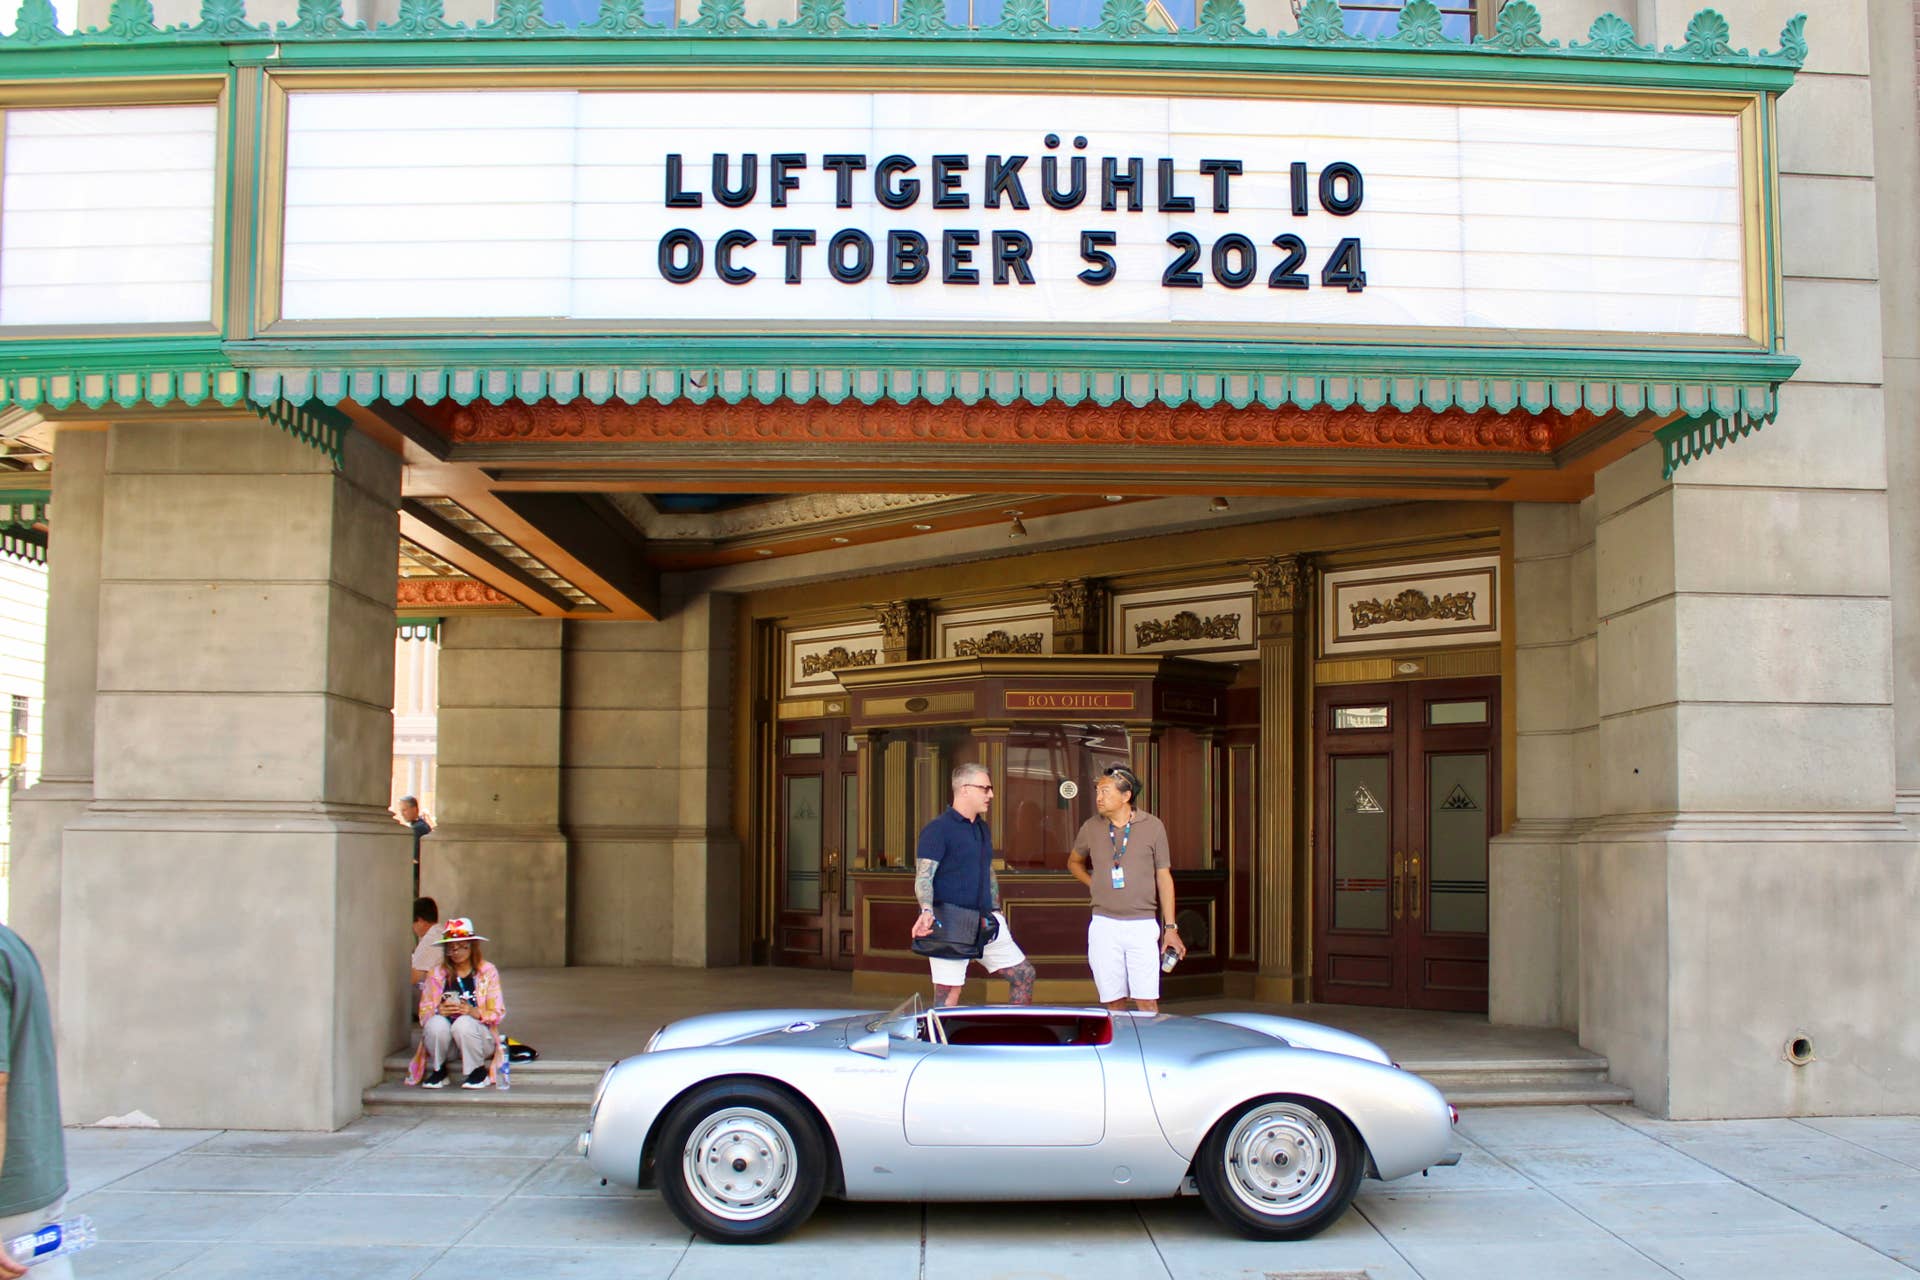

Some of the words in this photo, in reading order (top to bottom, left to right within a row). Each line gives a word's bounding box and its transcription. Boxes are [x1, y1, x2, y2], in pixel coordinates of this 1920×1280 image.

[665, 133, 1243, 216] LUFTGEKÜHLT
[657, 228, 1036, 286] OCTOBER
[1077, 230, 1117, 287] 5
[1161, 231, 1367, 293] 2024
[1027, 694, 1056, 707] BOX
[1061, 694, 1110, 707] OFFICE
